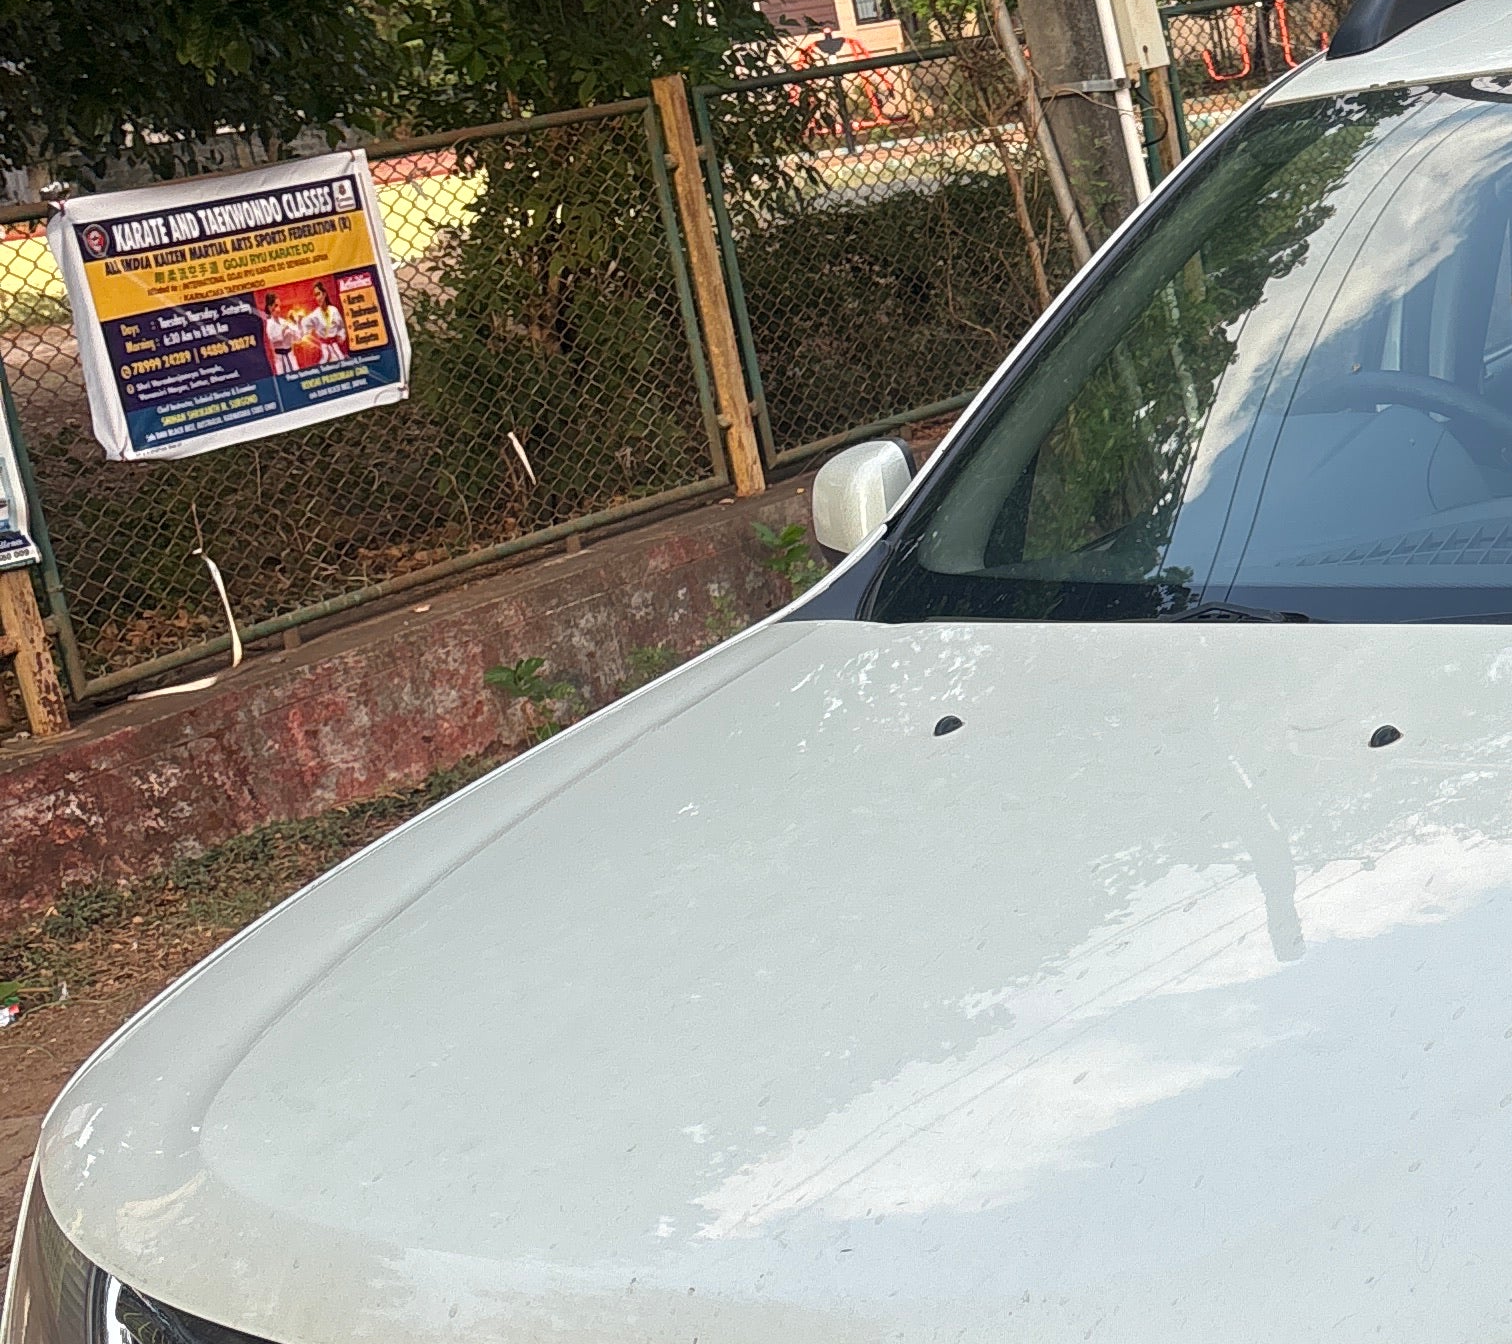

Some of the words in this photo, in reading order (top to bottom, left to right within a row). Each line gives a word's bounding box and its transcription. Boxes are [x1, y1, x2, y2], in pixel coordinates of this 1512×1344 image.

[113, 218, 167, 250] KARATE
[169, 213, 199, 240] AND
[199, 198, 281, 233] TAEKWONDO
[282, 187, 331, 217] CLASSES
[104, 260, 120, 275] ALL
[121, 256, 151, 271] INDIA
[153, 249, 186, 266] KAIZEN
[189, 241, 228, 260] MARTIAL
[231, 236, 252, 251] ARTS
[254, 229, 286, 247] SPORTS
[288, 220, 336, 239] FEDERATION
[223, 256, 248, 270] GOJU
[249, 252, 266, 264] RYU
[268, 244, 300, 260] KARATE
[301, 241, 314, 254] DO
[120, 324, 139, 336] Days
